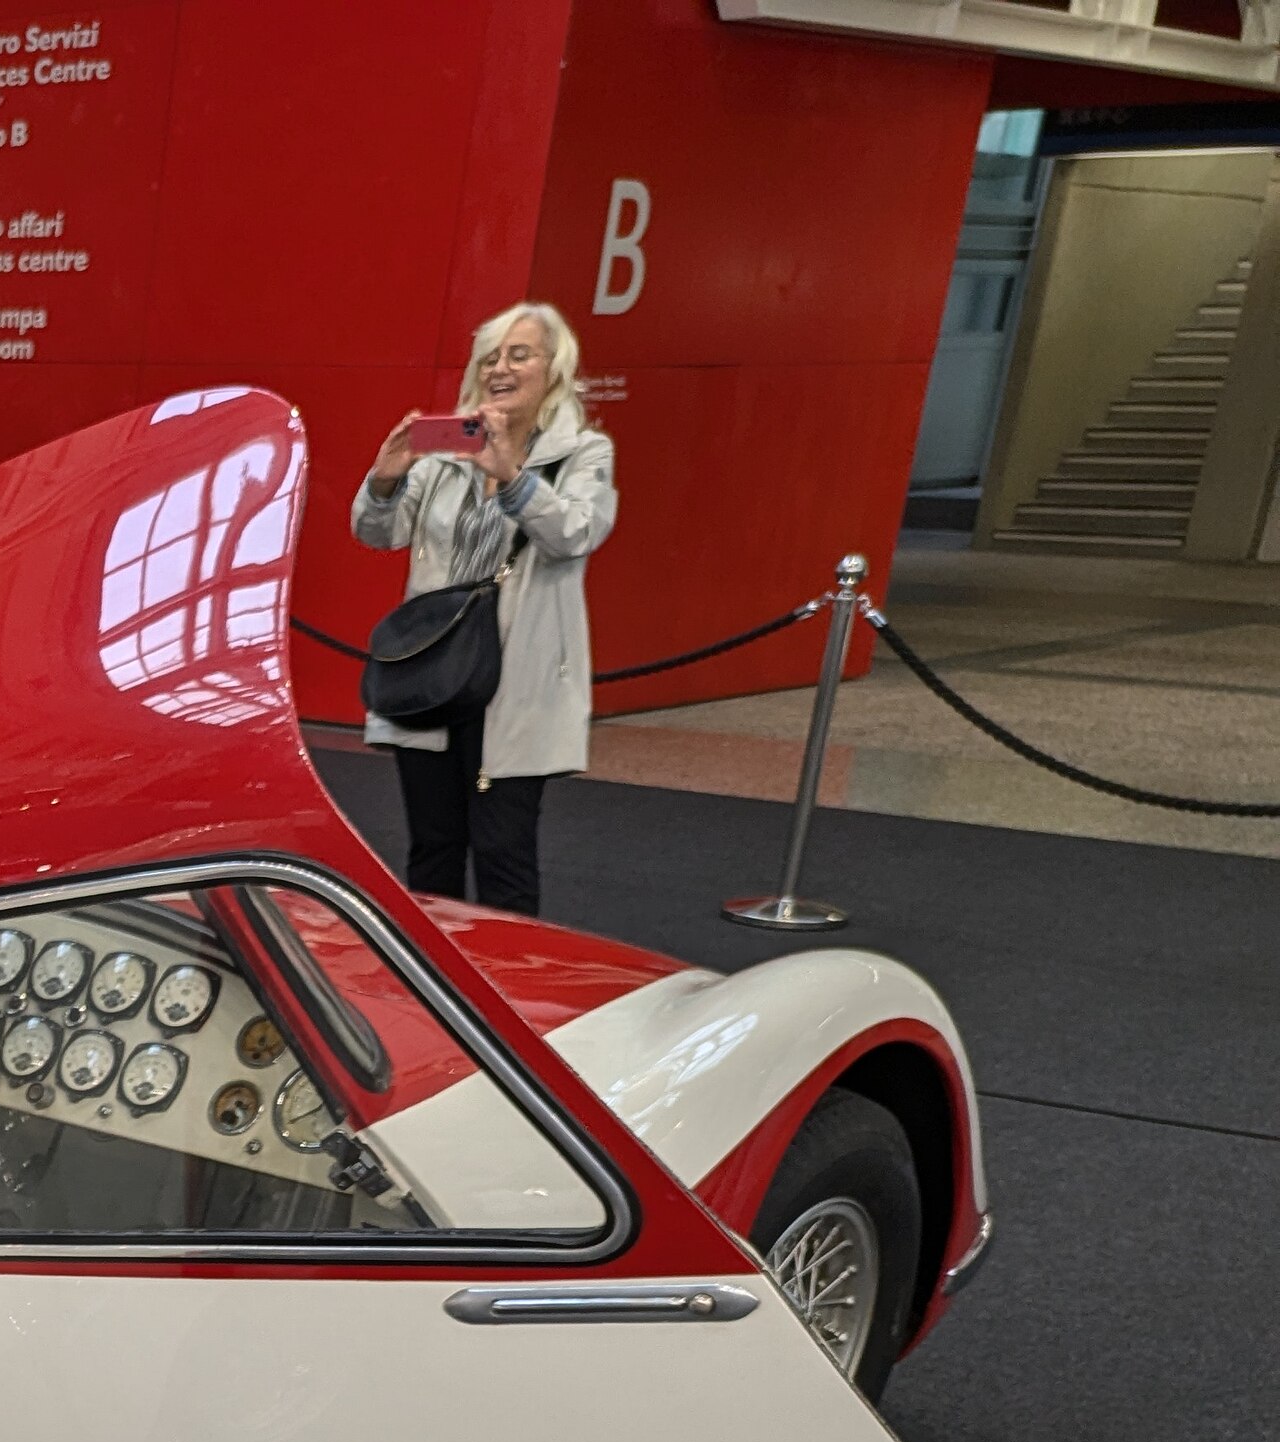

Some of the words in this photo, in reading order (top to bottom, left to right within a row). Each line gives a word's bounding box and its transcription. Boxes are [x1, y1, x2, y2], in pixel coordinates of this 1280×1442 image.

[25, 21, 101, 53] Servizi
[34, 57, 112, 85] Centre
[10, 120, 29, 148] B
[8, 210, 65, 239] affari
[17, 249, 90, 273] centre
[592, 179, 651, 315] B
